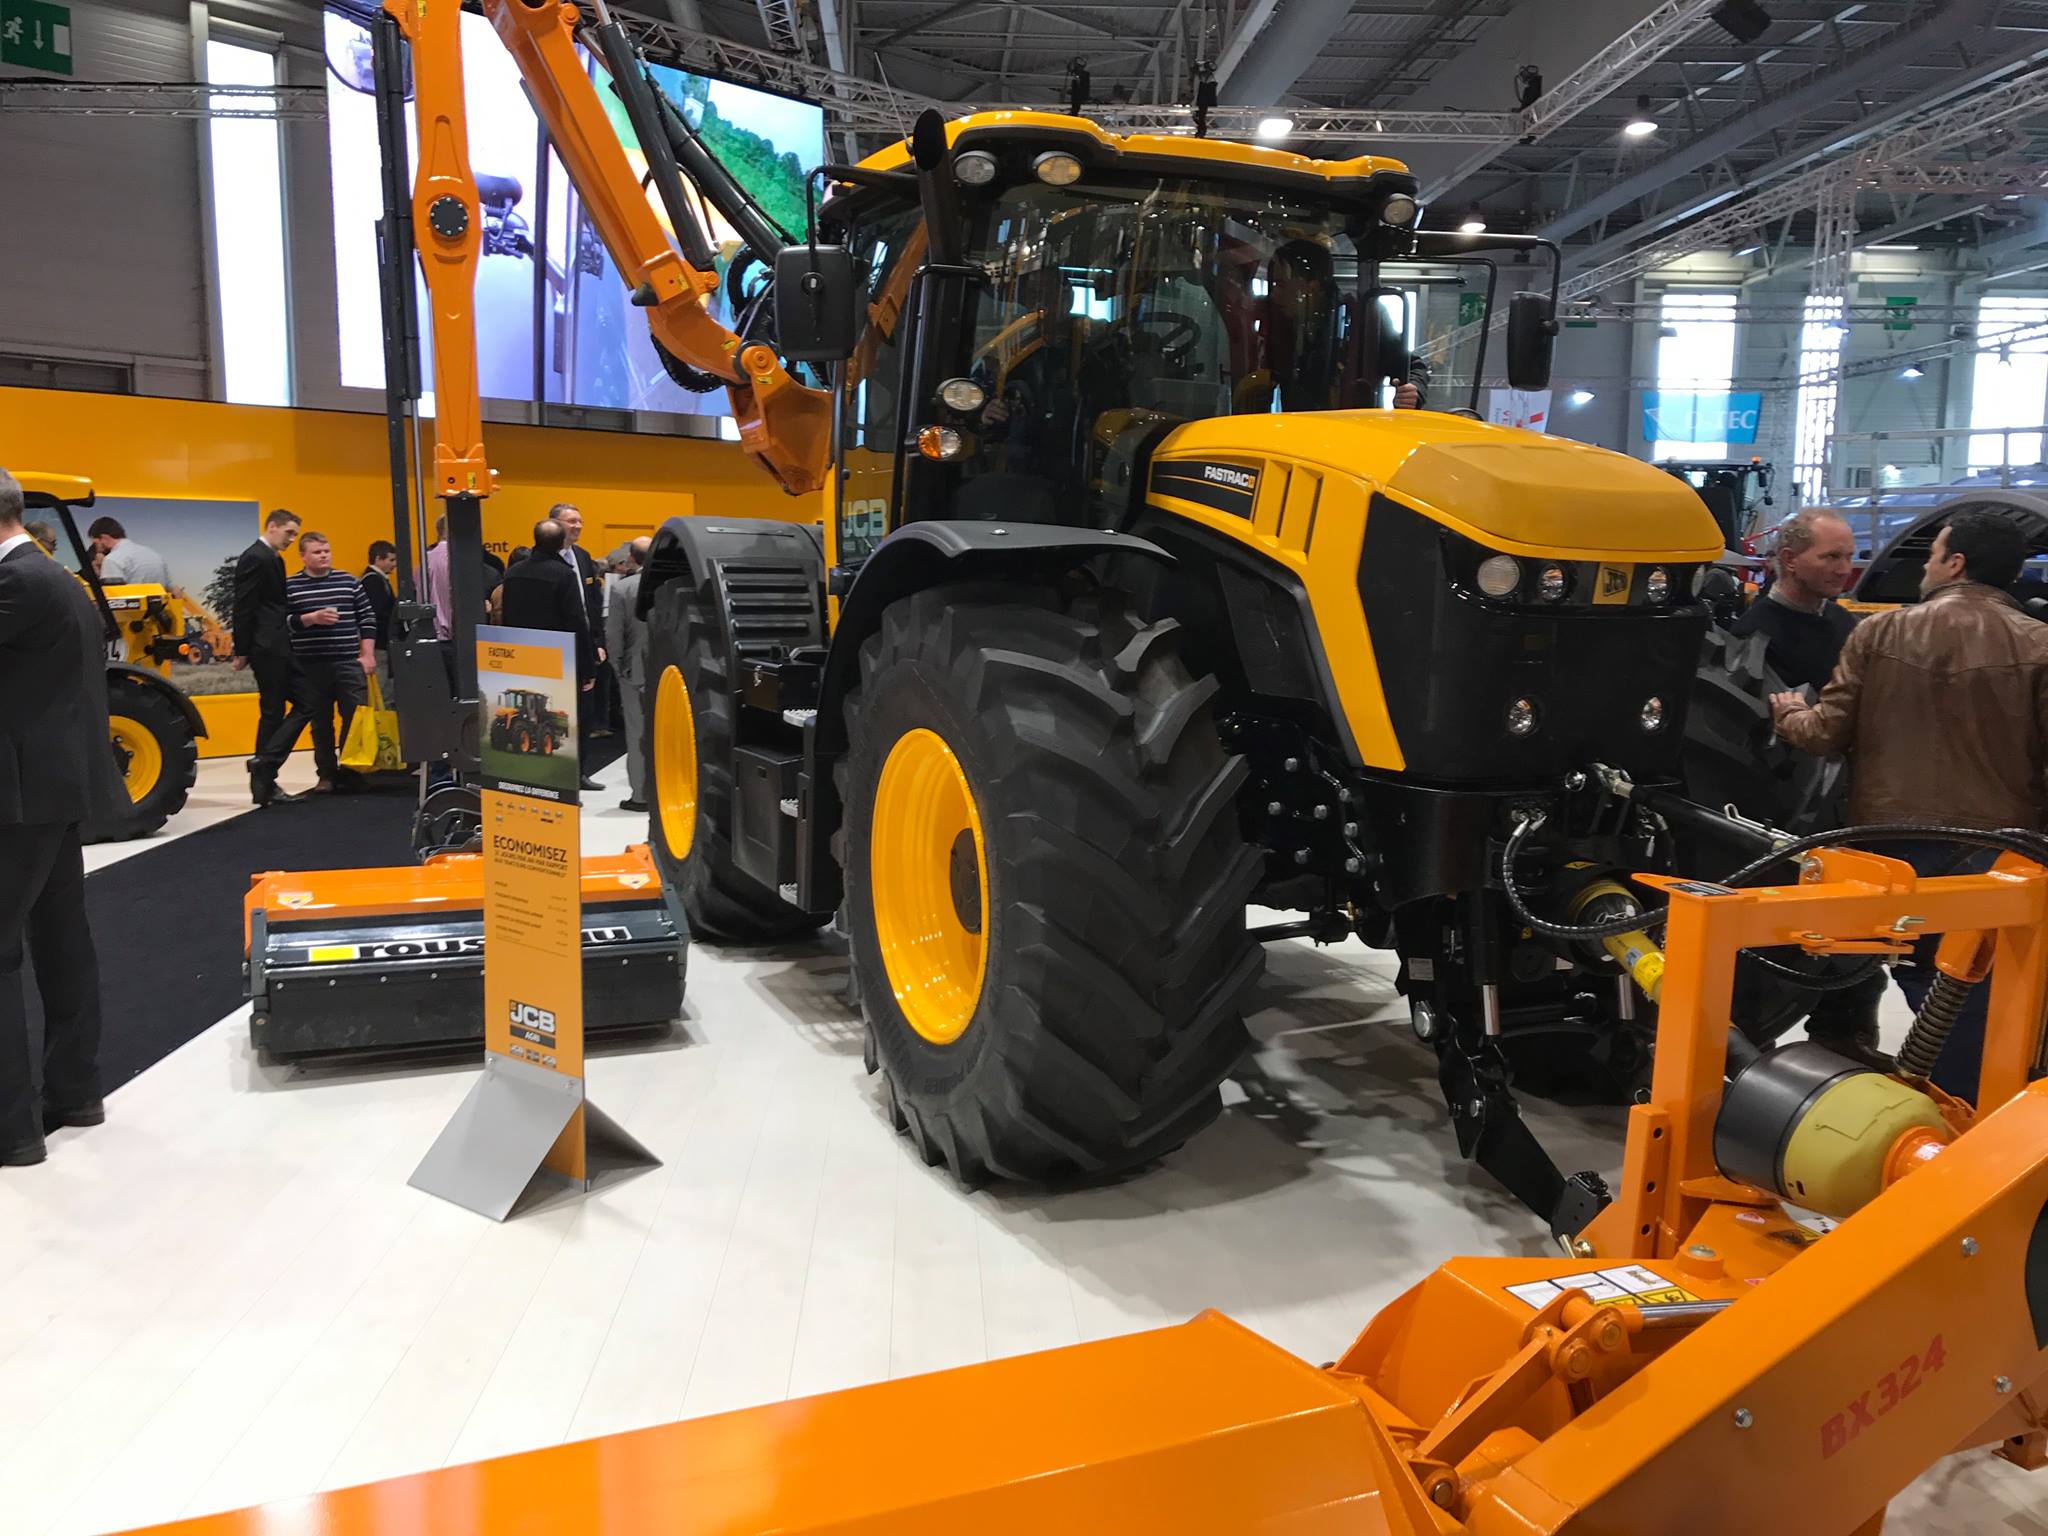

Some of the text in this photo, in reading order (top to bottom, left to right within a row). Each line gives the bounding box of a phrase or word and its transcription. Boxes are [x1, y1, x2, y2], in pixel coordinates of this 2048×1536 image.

[1204, 465, 1249, 487] FASTRAC
[842, 498, 887, 538] JCB
[493, 835, 568, 862] ECONOMISEZ
[510, 1003, 555, 1033] JCB
[1821, 1333, 1946, 1459] BX 324
